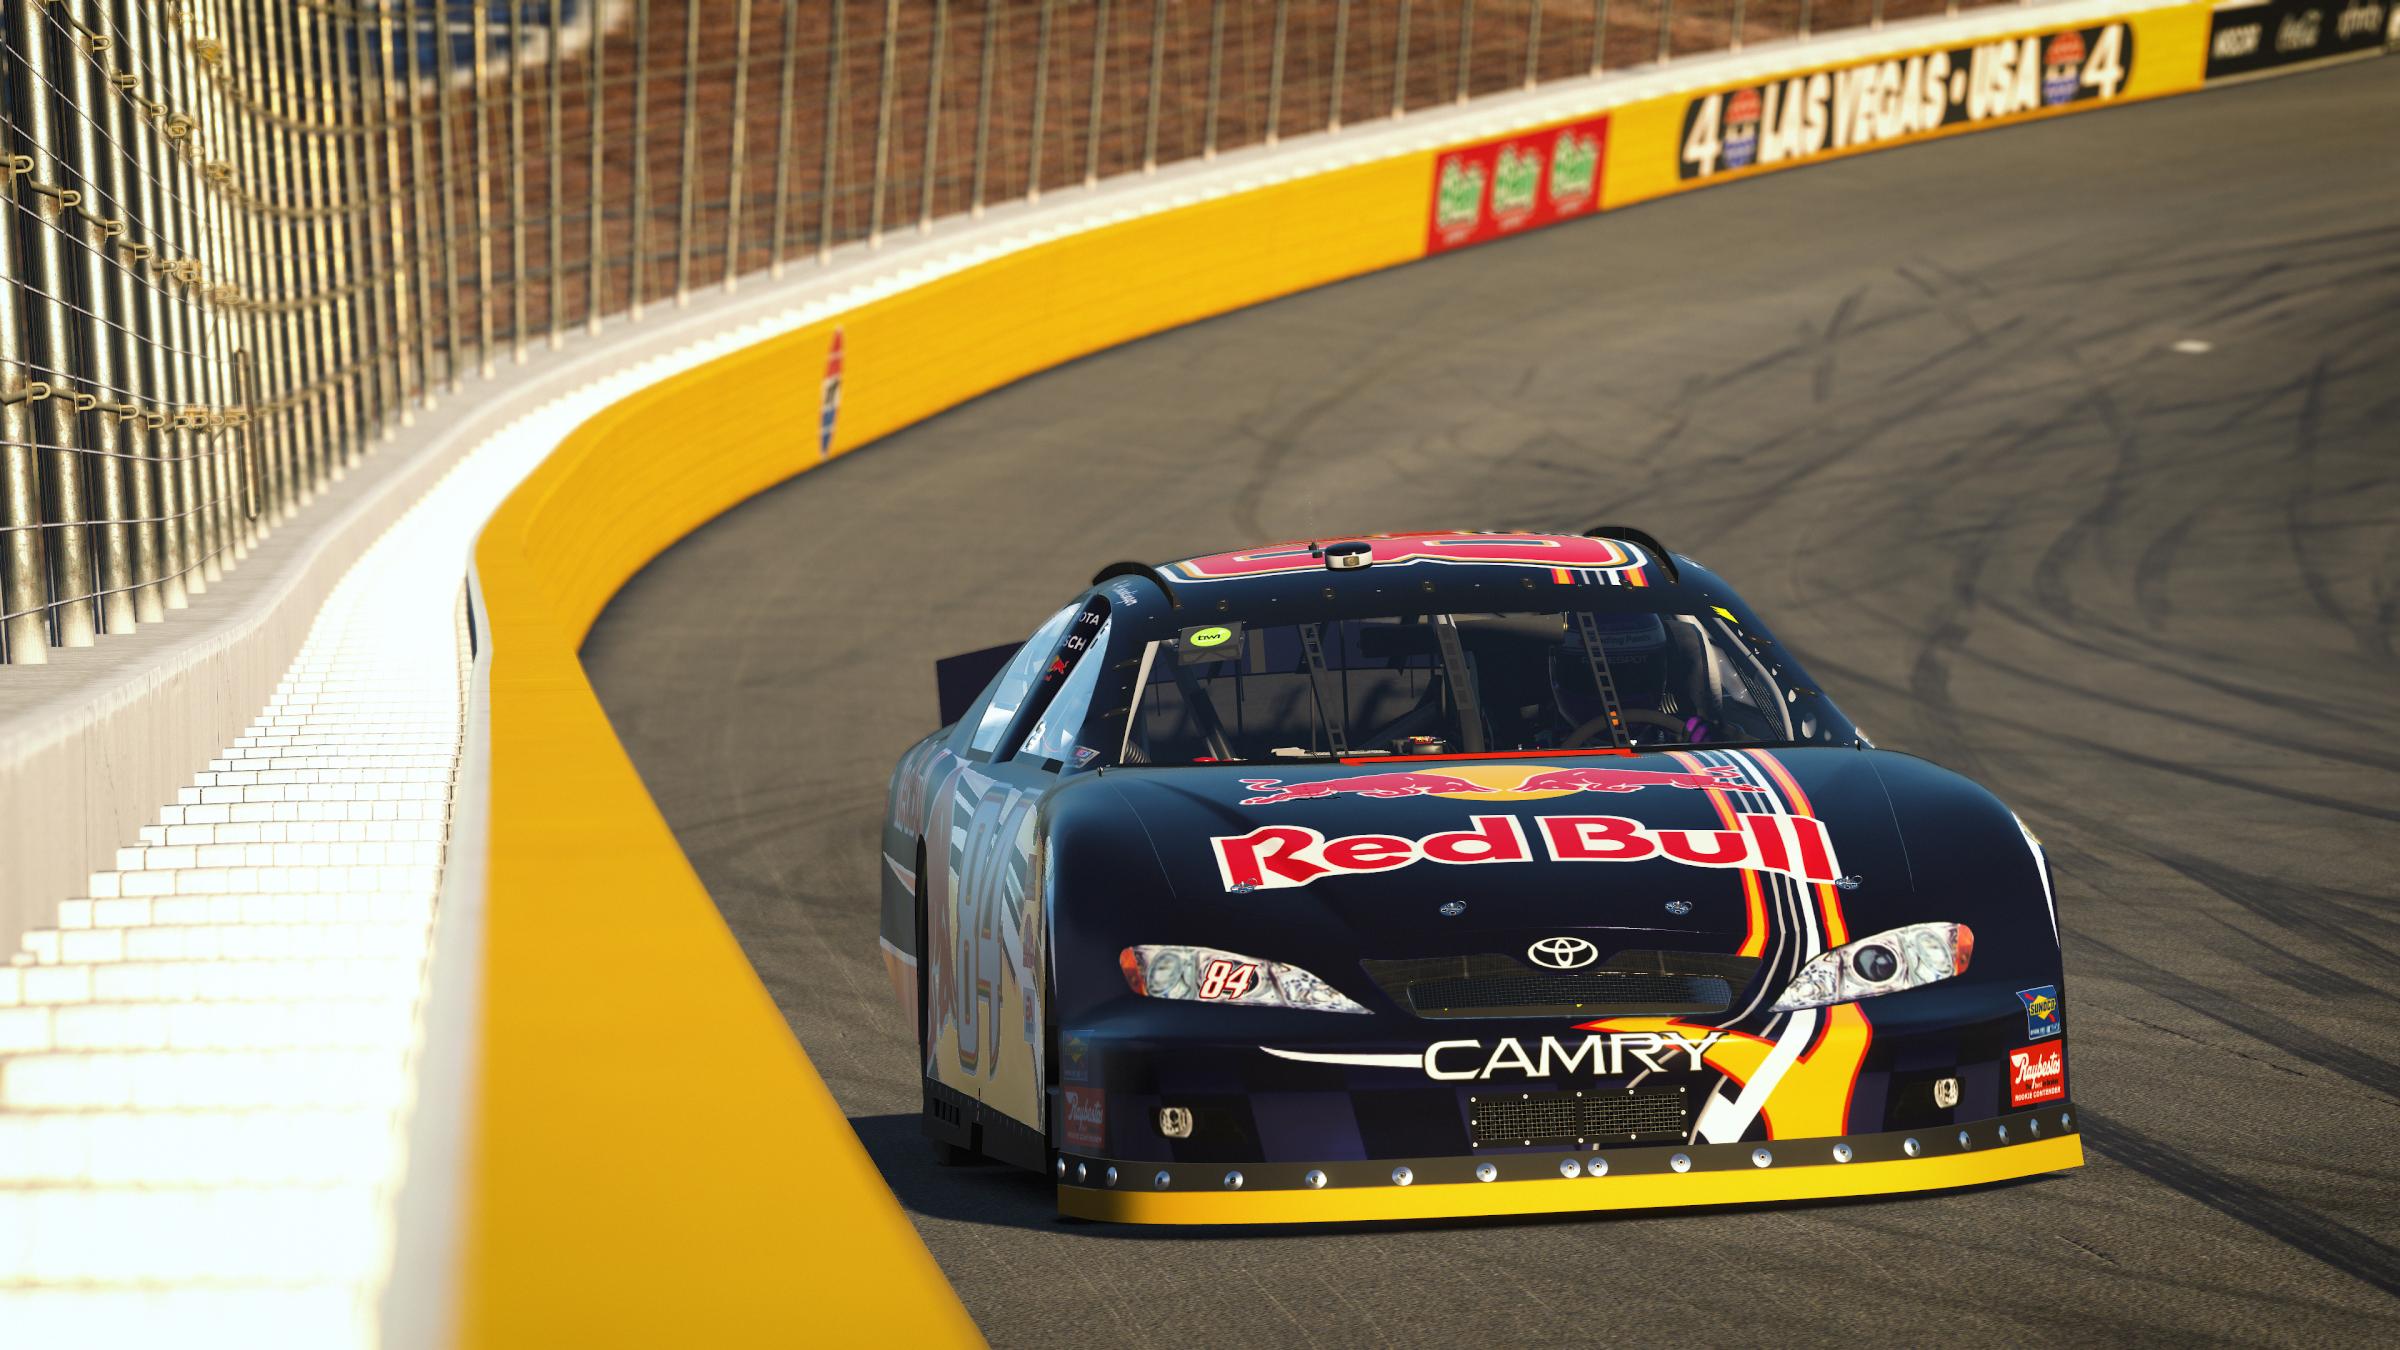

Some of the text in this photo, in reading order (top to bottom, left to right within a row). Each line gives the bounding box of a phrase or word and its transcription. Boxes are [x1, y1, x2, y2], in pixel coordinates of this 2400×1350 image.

[1682, 95, 1722, 176] 4
[1757, 79, 1830, 164] LAS
[1832, 52, 1951, 149] VEGAS
[1966, 35, 2042, 120] USA
[2080, 24, 2124, 98] 4
[1212, 814, 1842, 890] Red Bull
[1200, 959, 1257, 1000] 84
[2030, 999, 2056, 1015] SUNOCO
[1423, 1031, 1729, 1081] CAMRY
